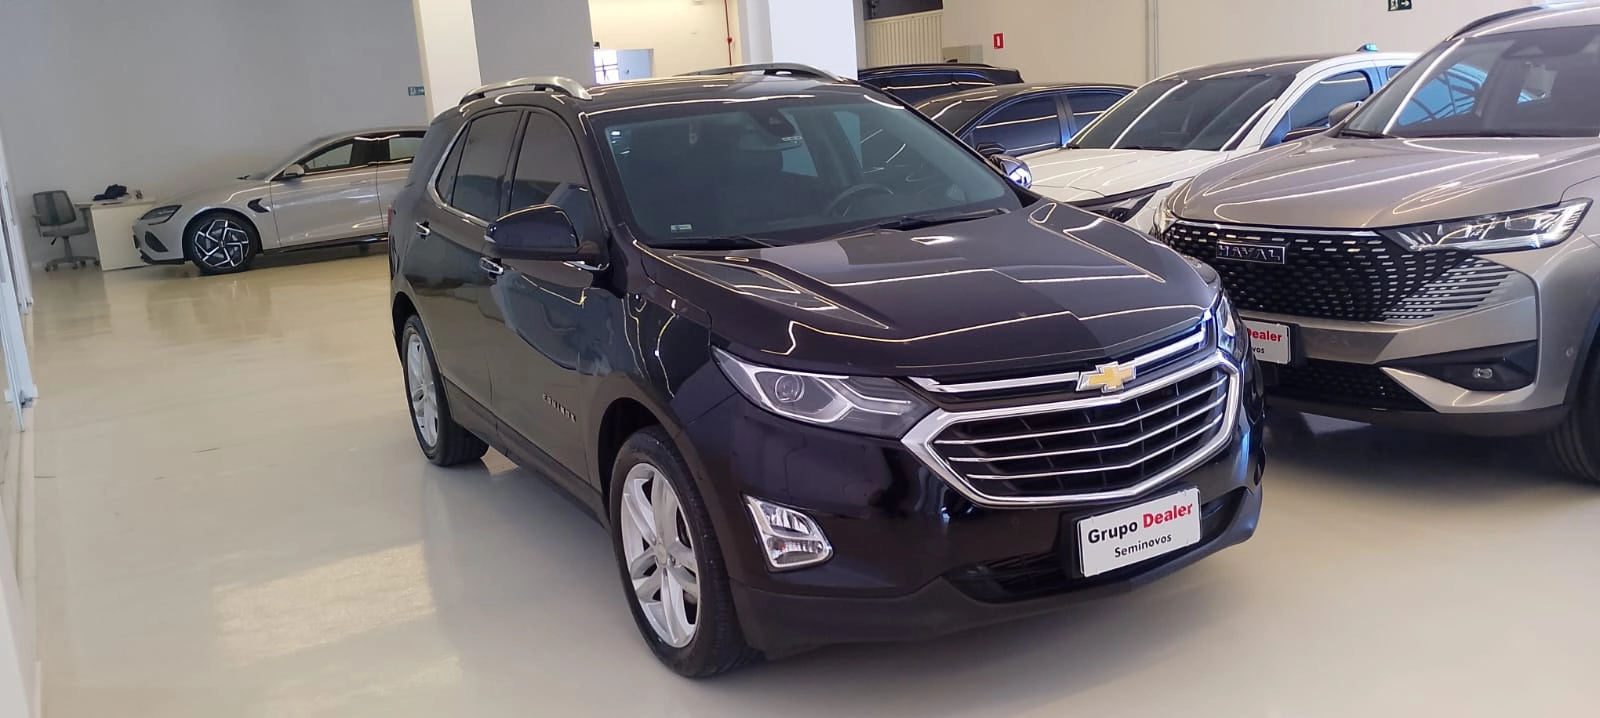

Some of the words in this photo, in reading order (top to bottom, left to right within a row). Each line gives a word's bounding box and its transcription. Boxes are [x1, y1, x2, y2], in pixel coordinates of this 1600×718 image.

[1218, 244, 1281, 261] HAVAL
[1088, 521, 1138, 544] Grupo
[1142, 503, 1193, 529] Dealer
[1114, 533, 1172, 558] Seminovos
